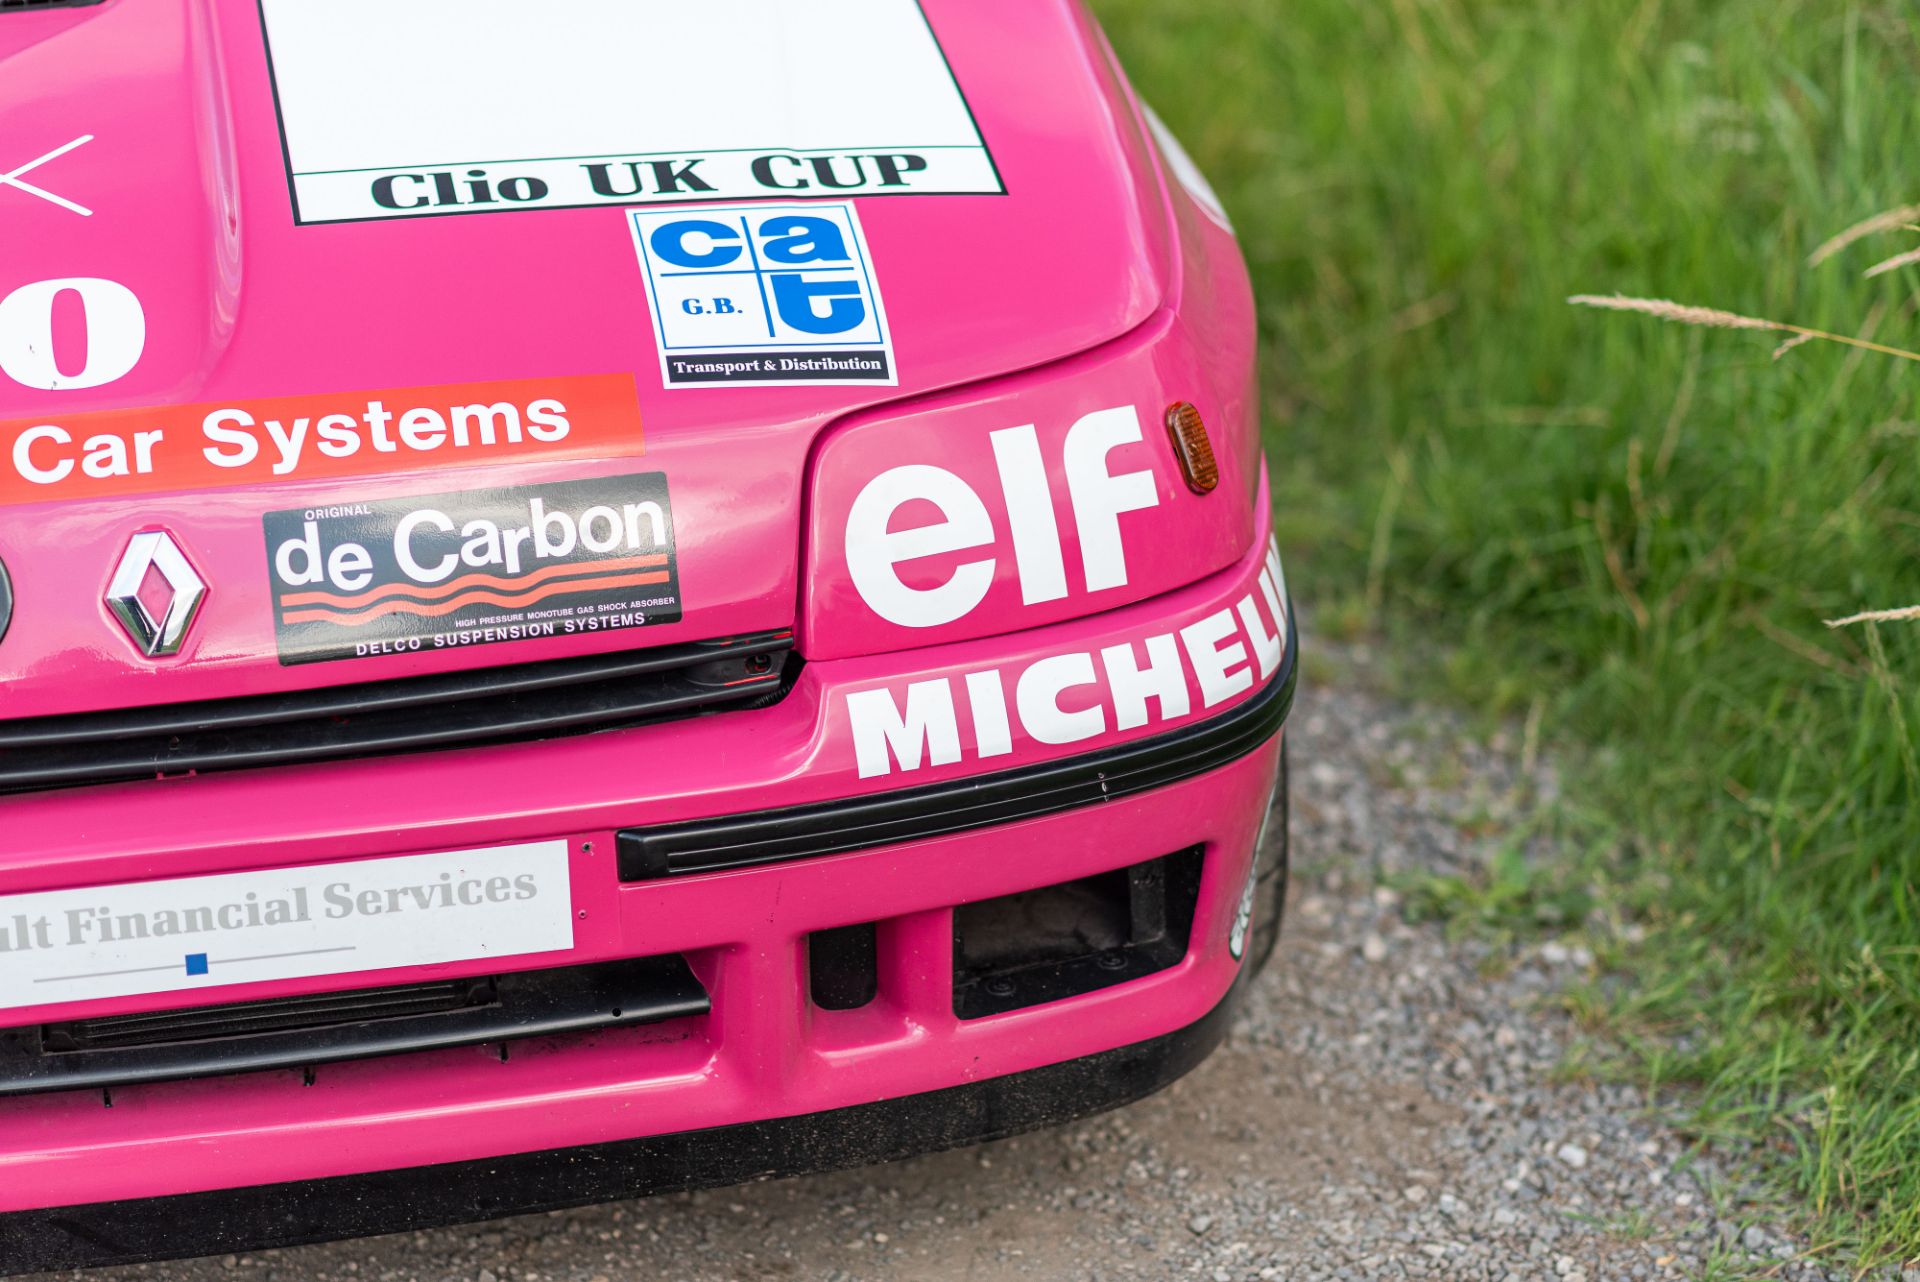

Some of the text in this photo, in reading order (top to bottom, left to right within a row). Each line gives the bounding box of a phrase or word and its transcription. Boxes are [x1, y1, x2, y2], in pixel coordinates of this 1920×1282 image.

[370, 153, 928, 210] Clio UK CUP
[681, 297, 743, 315] G.B.
[673, 357, 882, 376] Transport & Distribution
[12, 398, 571, 484] Car Systems
[304, 504, 372, 522] ORIGINAL
[844, 404, 1160, 628] elf
[275, 497, 667, 592] de Carbon
[356, 612, 646, 656] DELCO SUSPENSION SYSTEMS
[455, 597, 675, 628] HIGH PRESSURE MONOTUBE GAS SHOCK ABSORBER
[0, 872, 538, 952] lt Financial Services
